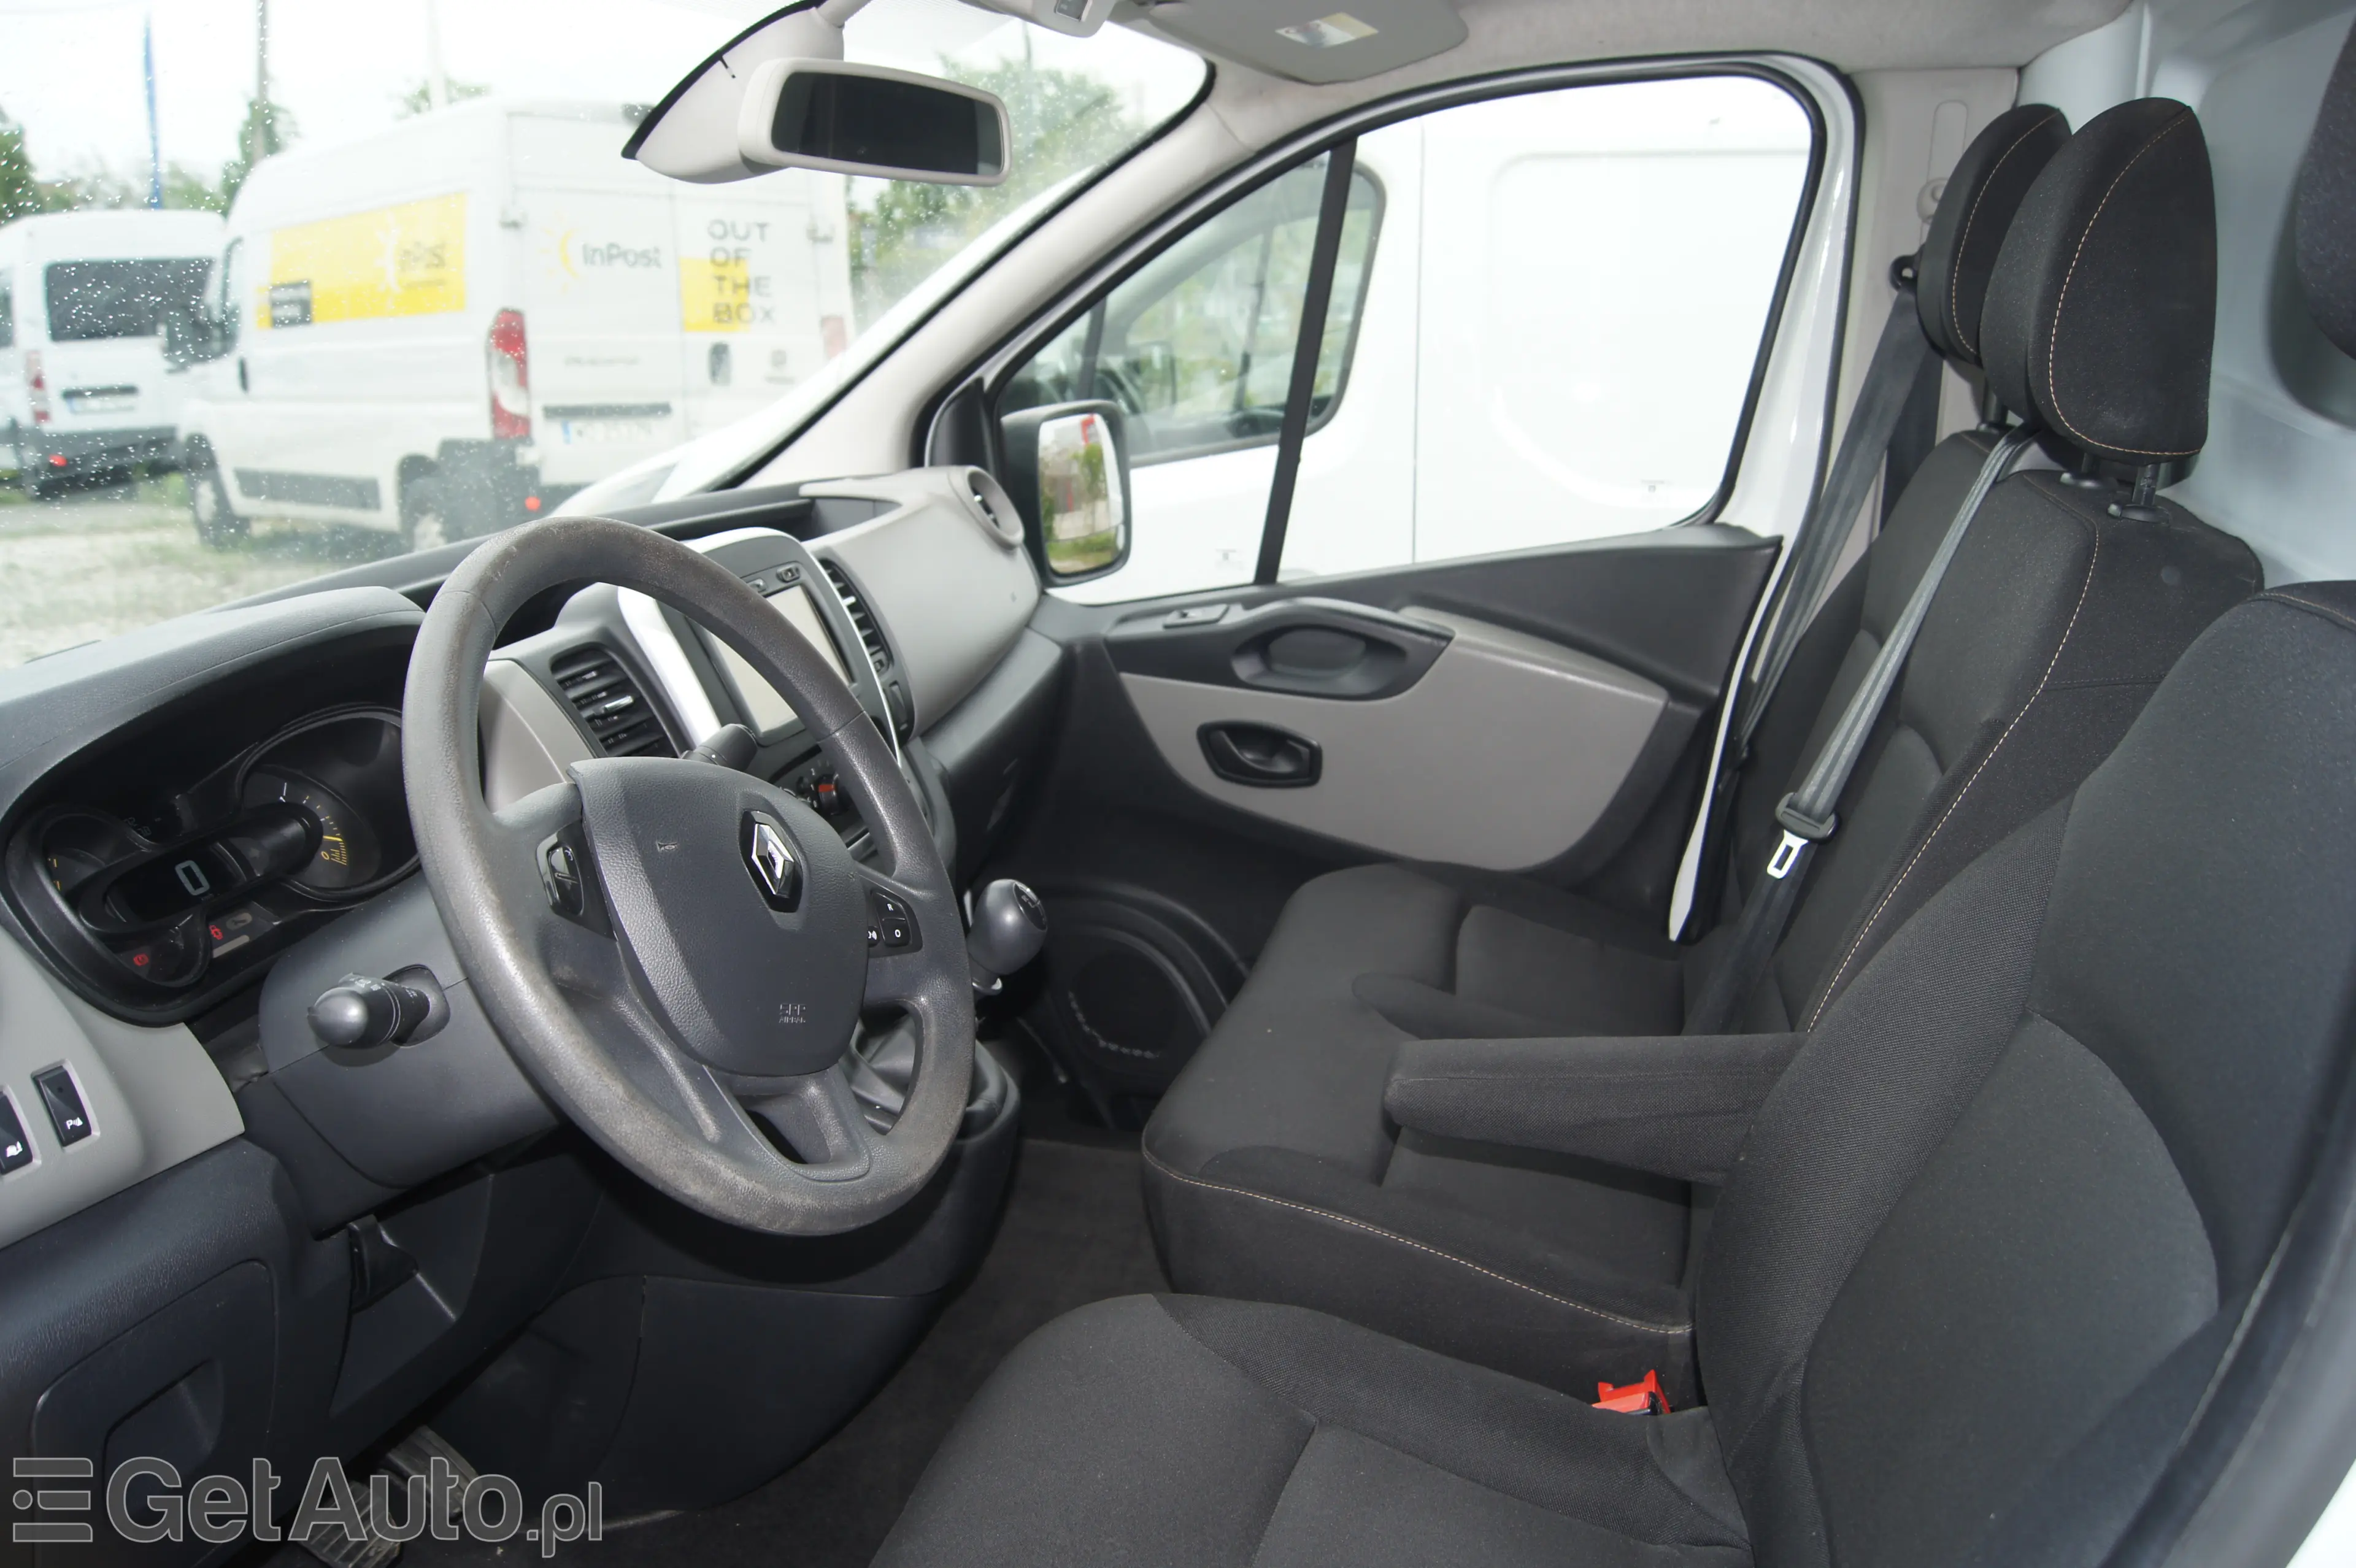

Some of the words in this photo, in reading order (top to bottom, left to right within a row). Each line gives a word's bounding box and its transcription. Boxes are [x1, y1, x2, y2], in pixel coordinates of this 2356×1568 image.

[707, 218, 771, 243] OUT
[709, 246, 753, 269] OF
[713, 275, 772, 298] THE
[714, 302, 777, 325] BOX
[887, 903, 894, 912] R
